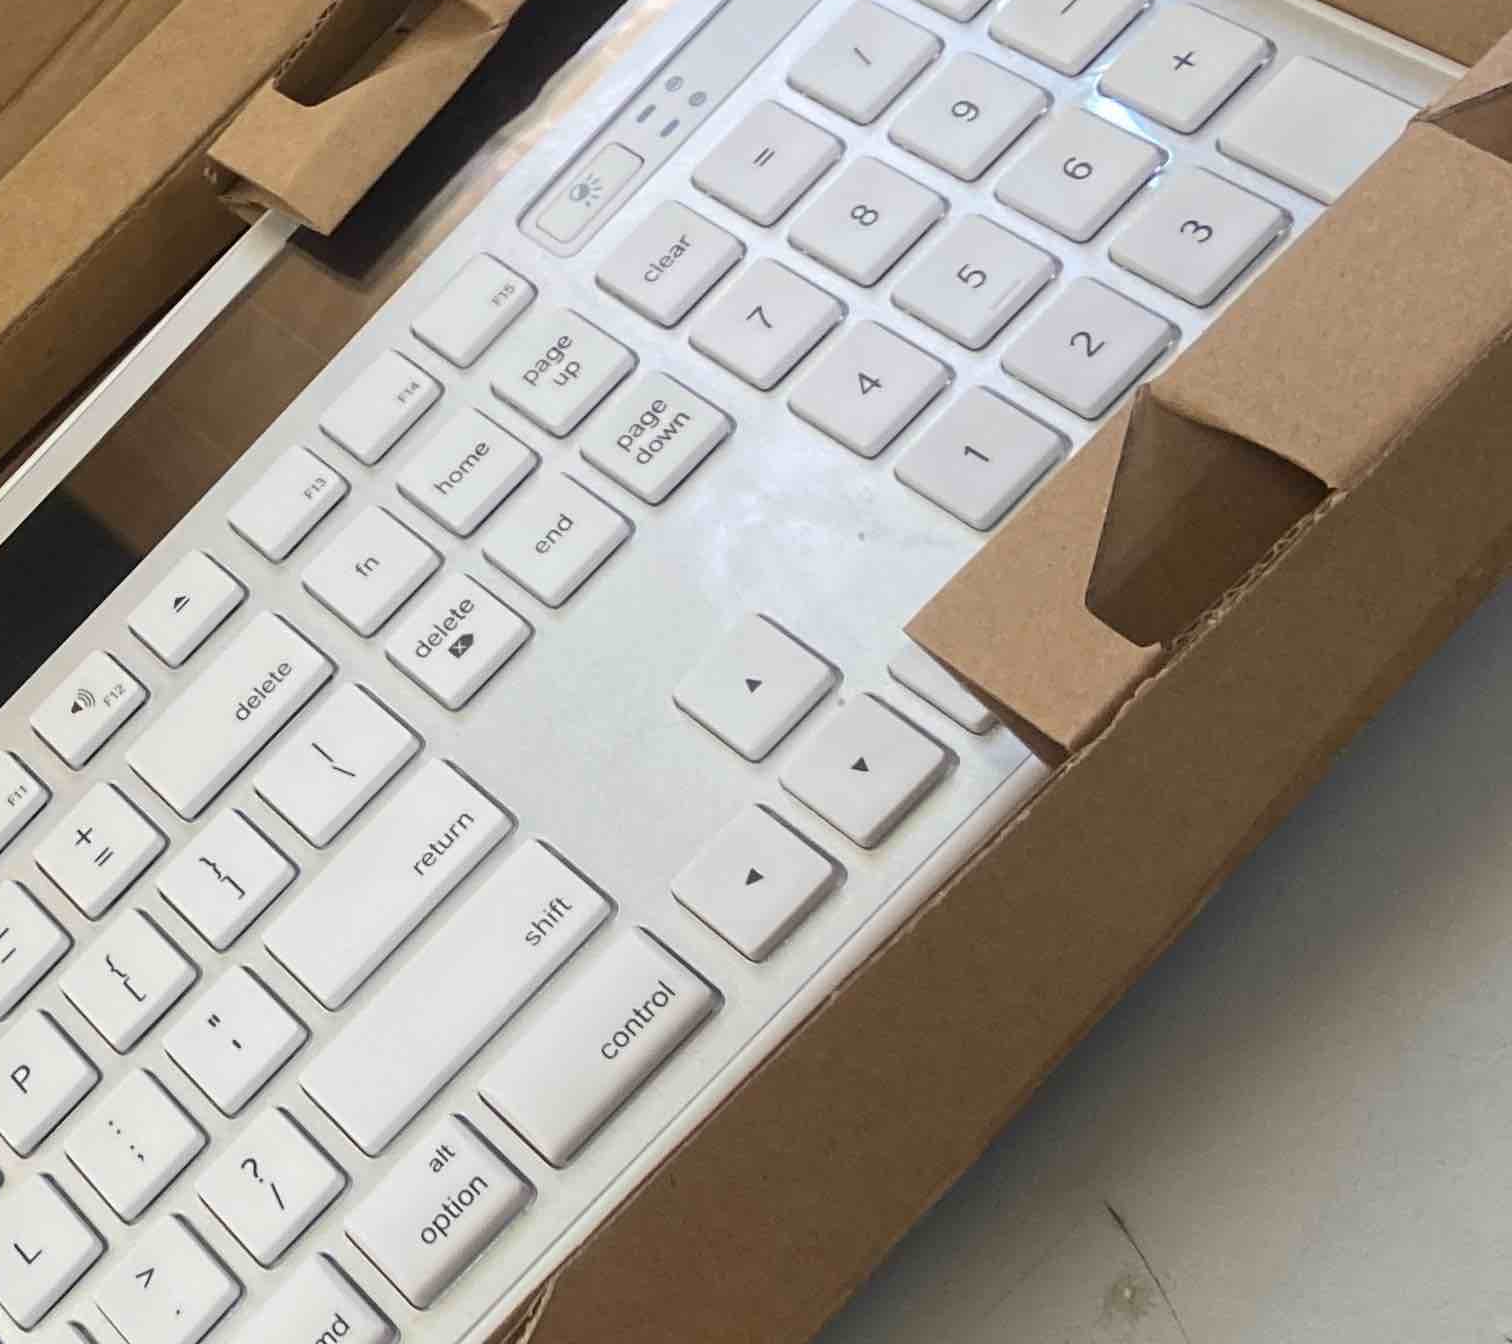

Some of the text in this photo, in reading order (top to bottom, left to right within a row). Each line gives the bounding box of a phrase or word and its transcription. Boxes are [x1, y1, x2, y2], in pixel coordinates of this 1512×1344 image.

[950, 99, 981, 124] 9
[1062, 155, 1095, 181] 6
[849, 203, 880, 228] 8
[1178, 218, 1215, 244] 3
[642, 233, 692, 284] clear
[955, 262, 988, 290] 5
[744, 304, 774, 330] 7
[1068, 330, 1106, 359] 2
[521, 334, 574, 388] page
[552, 360, 582, 388] up
[856, 371, 884, 397] 4
[615, 398, 668, 454] page
[635, 411, 692, 466] down
[432, 441, 492, 496] home
[534, 512, 575, 555] end
[353, 556, 381, 578] fn
[414, 598, 476, 660] delete
[234, 662, 293, 722] delete
[412, 812, 476, 877] return
[524, 896, 574, 947] shift
[599, 979, 677, 1061] control
[9, 1063, 32, 1095] P
[239, 1156, 265, 1184] ?
[428, 1143, 457, 1174] alt
[419, 1175, 490, 1246] option
[12, 1242, 44, 1266] L
